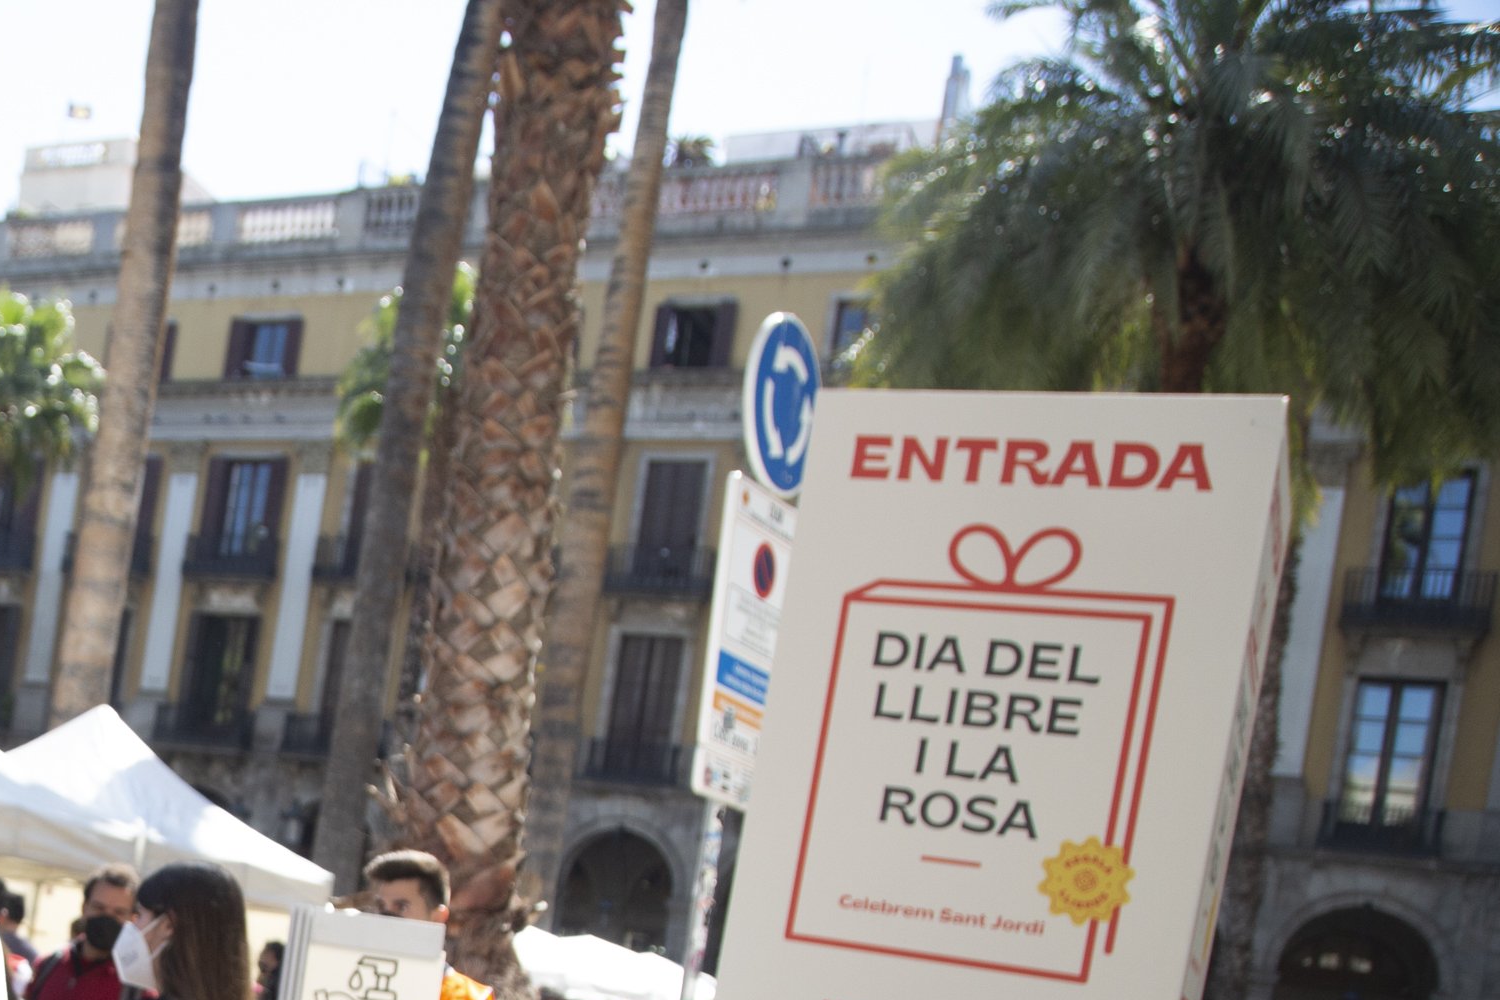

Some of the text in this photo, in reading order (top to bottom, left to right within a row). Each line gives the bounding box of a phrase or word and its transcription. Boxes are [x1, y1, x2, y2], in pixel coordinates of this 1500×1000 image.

[850, 435, 1213, 492] ENTRADA
[873, 631, 1100, 685] DIA DEL
[873, 682, 1083, 736] LLIBRE
[914, 738, 1019, 784] I LA
[879, 786, 1037, 839] ROSA
[838, 894, 1045, 935] Celebrem Sant Jordi
